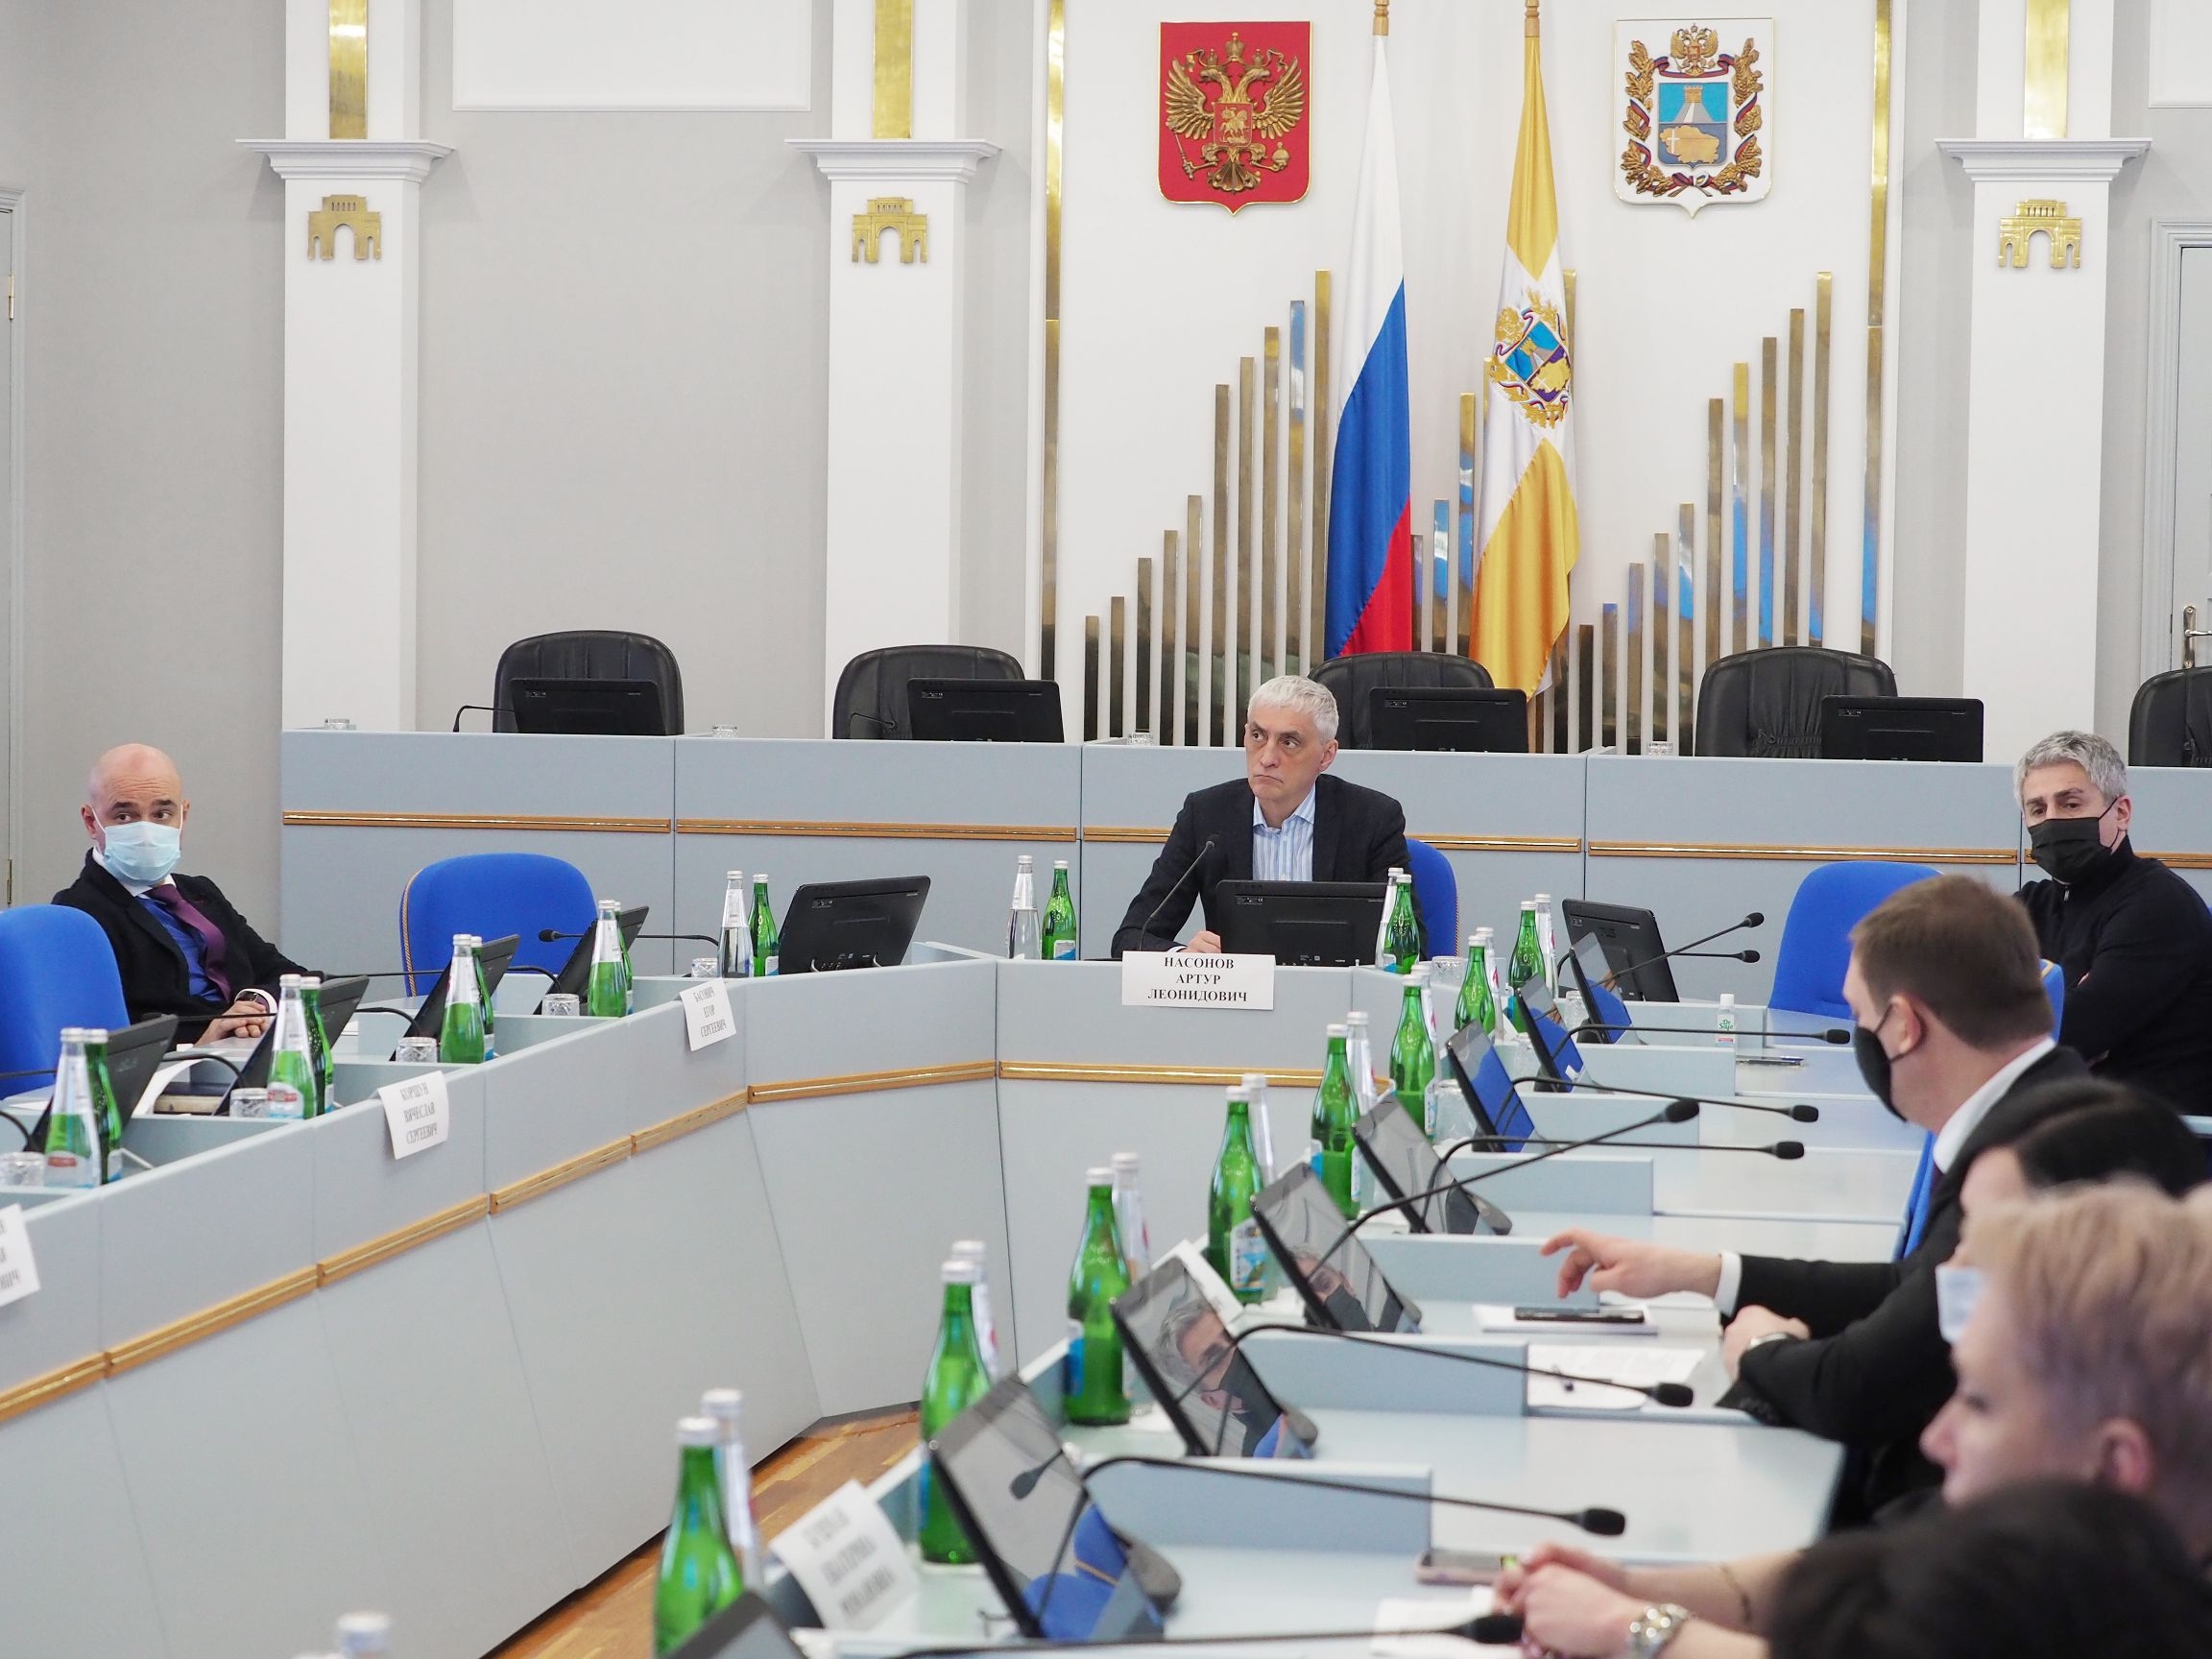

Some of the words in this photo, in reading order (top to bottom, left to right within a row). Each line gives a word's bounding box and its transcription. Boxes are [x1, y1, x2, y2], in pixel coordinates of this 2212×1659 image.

[1165, 957, 1235, 970] НАСОНОВ
[1176, 974, 1221, 985] АРТУР
[1147, 989, 1248, 1002] ЛЕОНИДОВИЧ
